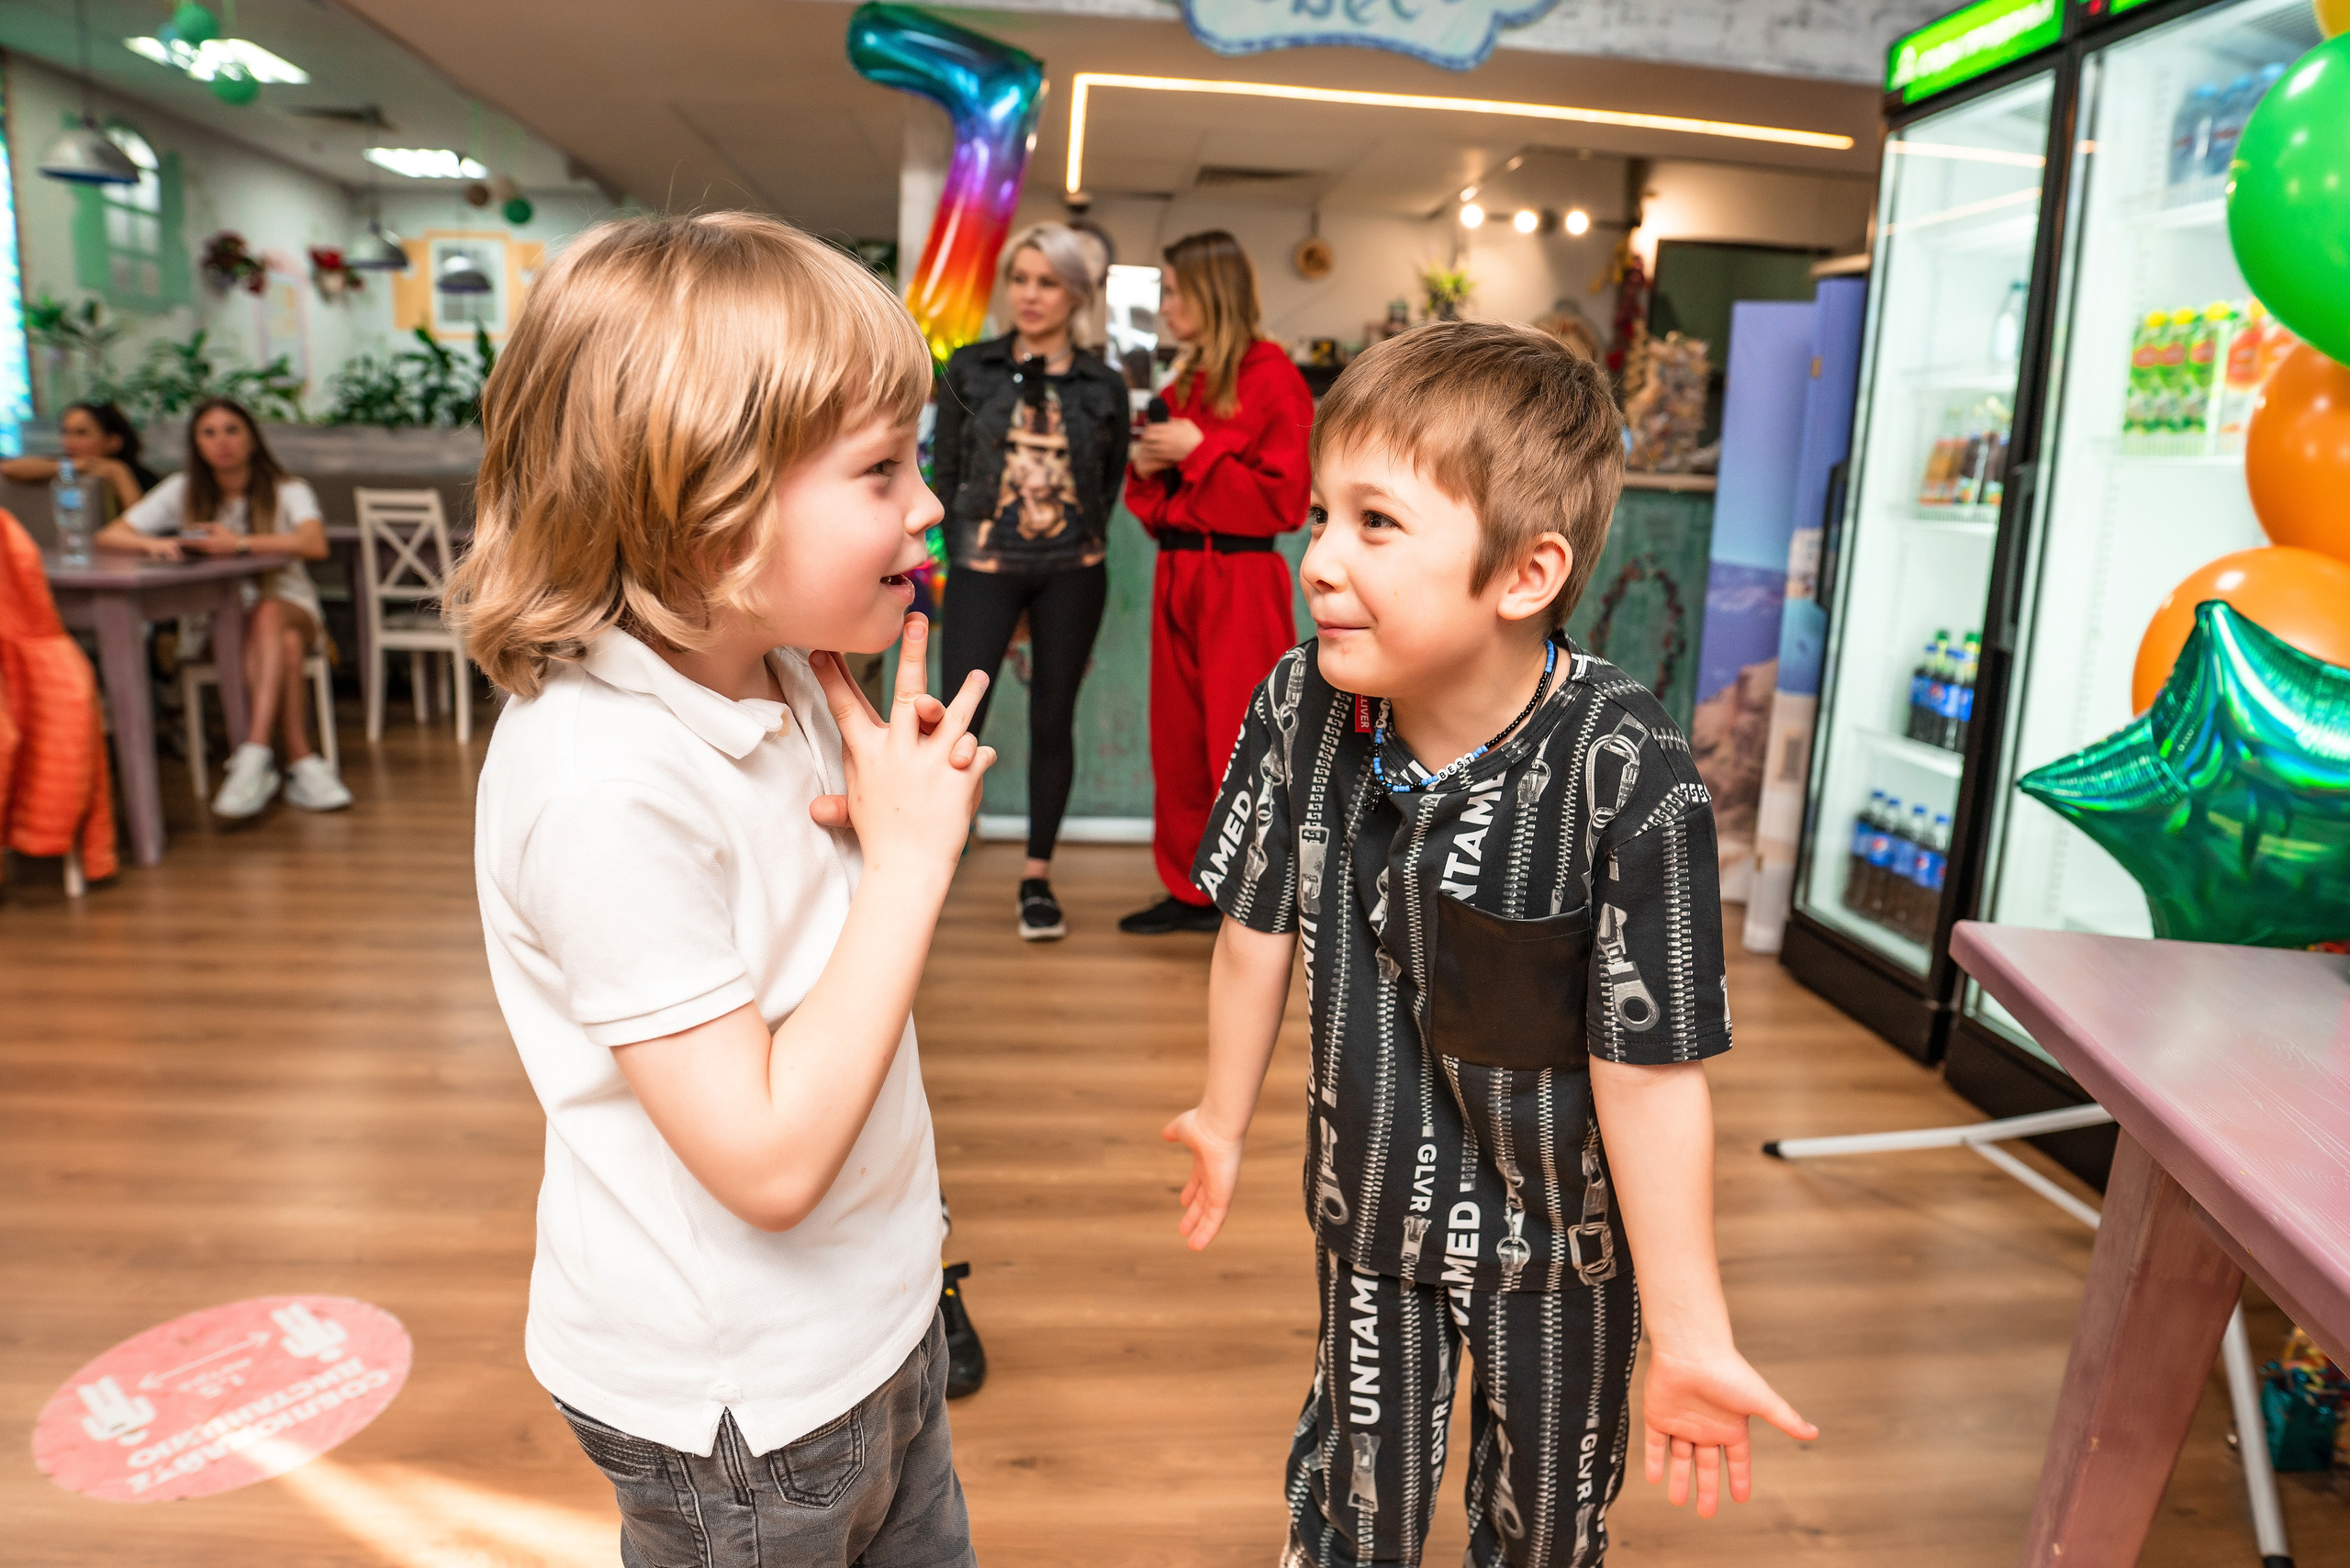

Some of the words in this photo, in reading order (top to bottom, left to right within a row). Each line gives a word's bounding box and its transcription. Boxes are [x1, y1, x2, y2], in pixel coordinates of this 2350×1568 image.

[1360, 694, 1370, 728] LIVER
[1438, 755, 1473, 780] BEST
[1195, 790, 1252, 902] AMED
[1409, 1143, 1437, 1212] GLVR
[1349, 1272, 1381, 1425] UNTAM
[1576, 1432, 1598, 1503] GLVR
